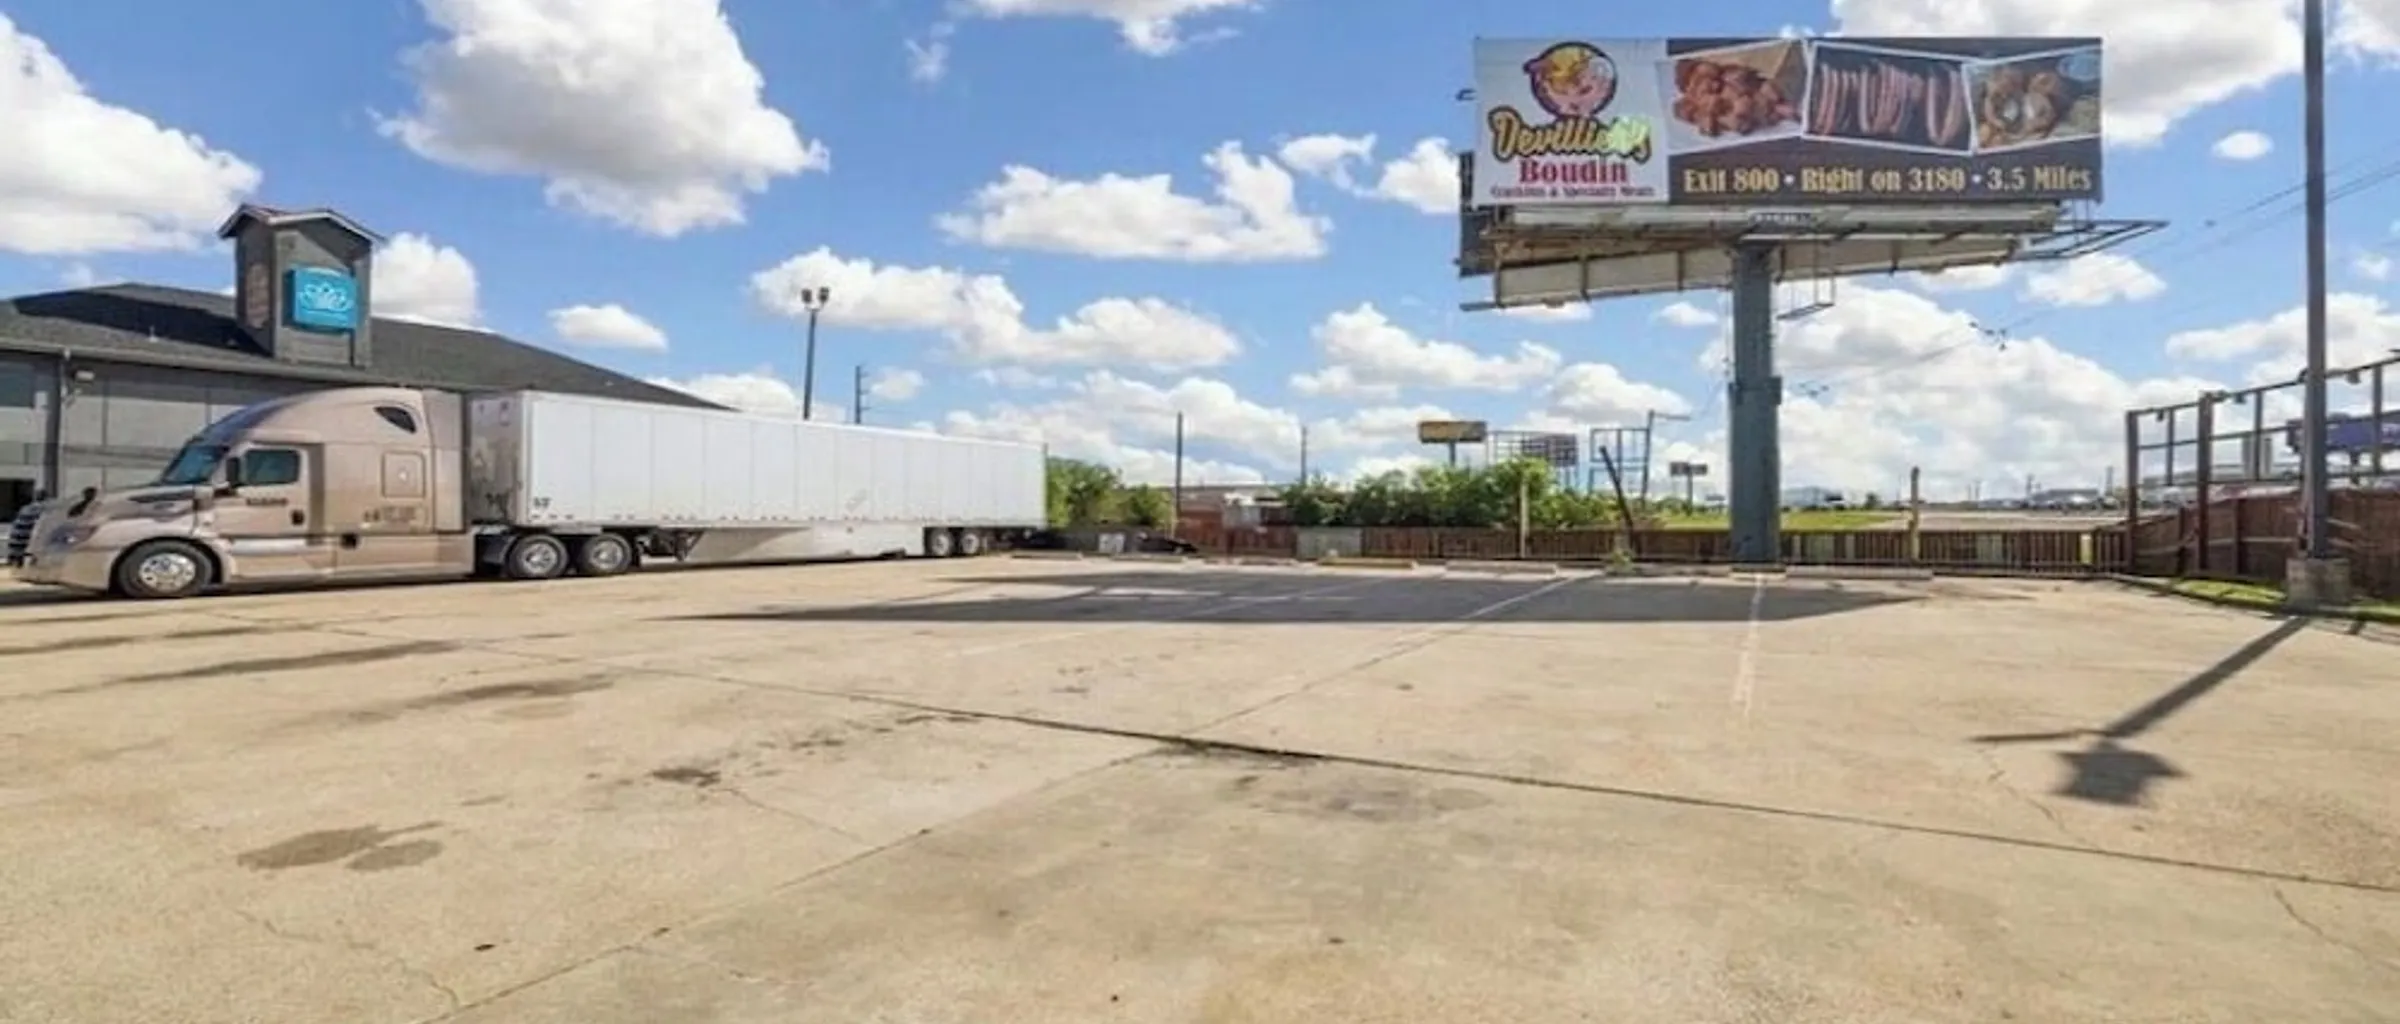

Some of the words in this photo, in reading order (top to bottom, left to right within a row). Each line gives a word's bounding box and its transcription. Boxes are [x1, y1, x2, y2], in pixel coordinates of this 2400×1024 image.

[1488, 105, 1652, 164] Devillies
[1519, 159, 1628, 183] Boudin
[1684, 168, 1727, 193] Exit
[1732, 167, 1780, 193] 800
[1801, 167, 1864, 194] Right
[1871, 171, 1901, 192] on
[1907, 167, 1966, 192] 3180
[1986, 166, 2026, 191] 3.5
[2033, 165, 2092, 191] Miles
